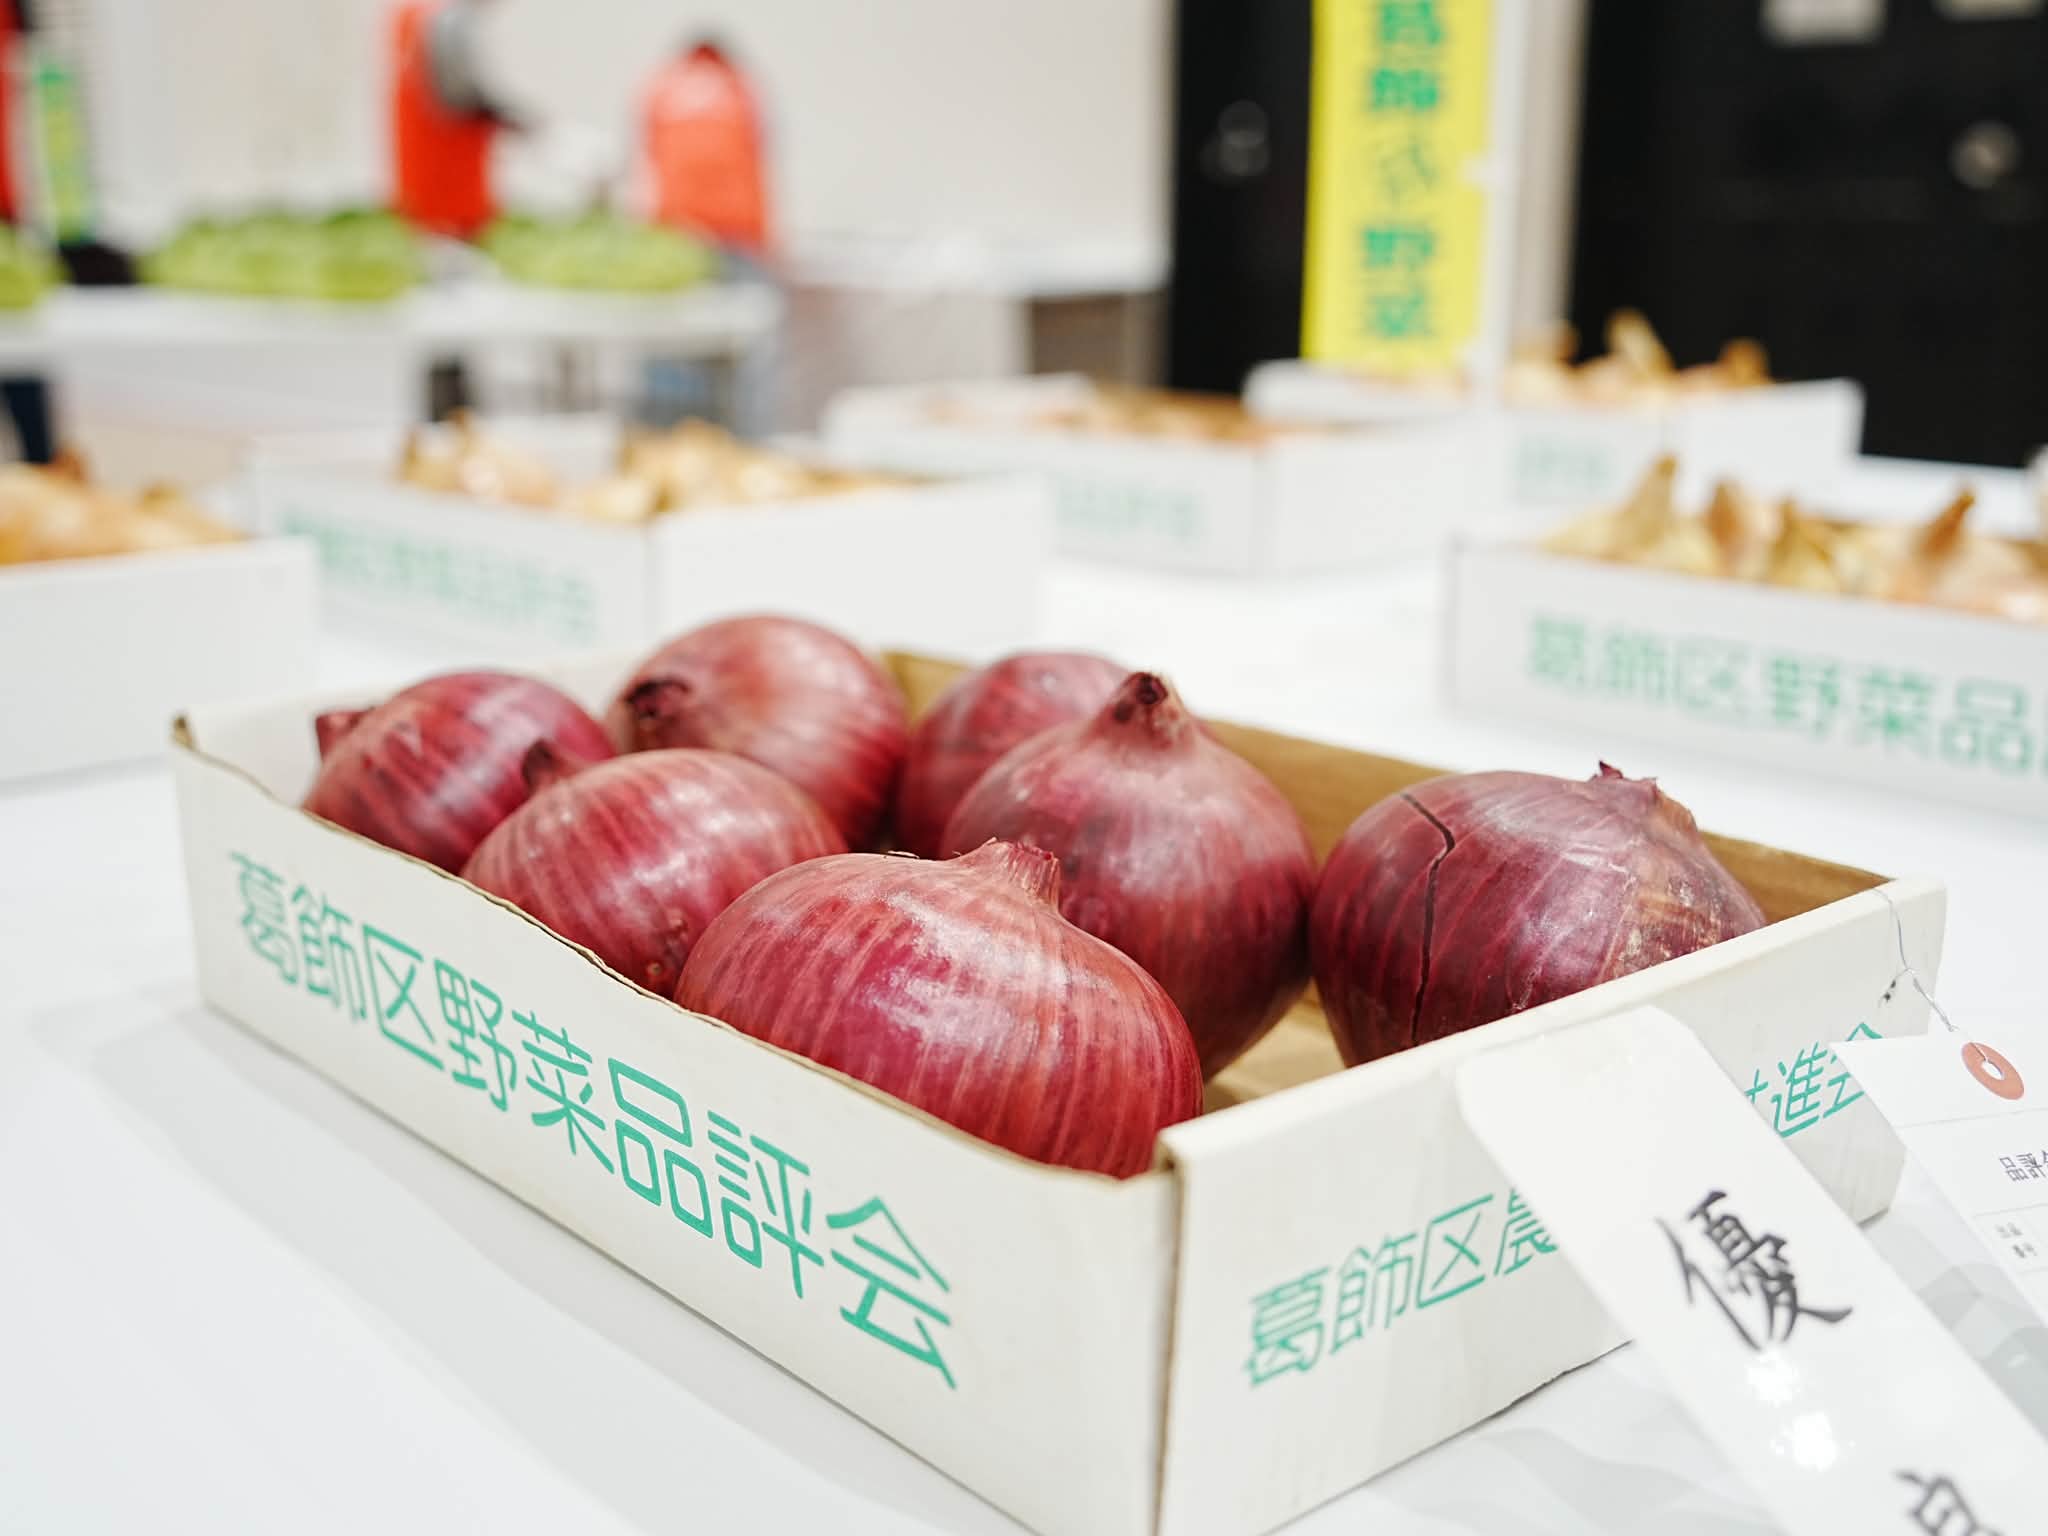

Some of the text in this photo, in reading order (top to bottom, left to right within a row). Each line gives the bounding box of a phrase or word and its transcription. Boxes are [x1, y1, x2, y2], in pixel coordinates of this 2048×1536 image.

[1528, 612, 2048, 775] 葛飾区野菜品
[228, 851, 957, 1390] 葛飾区野菜品評会
